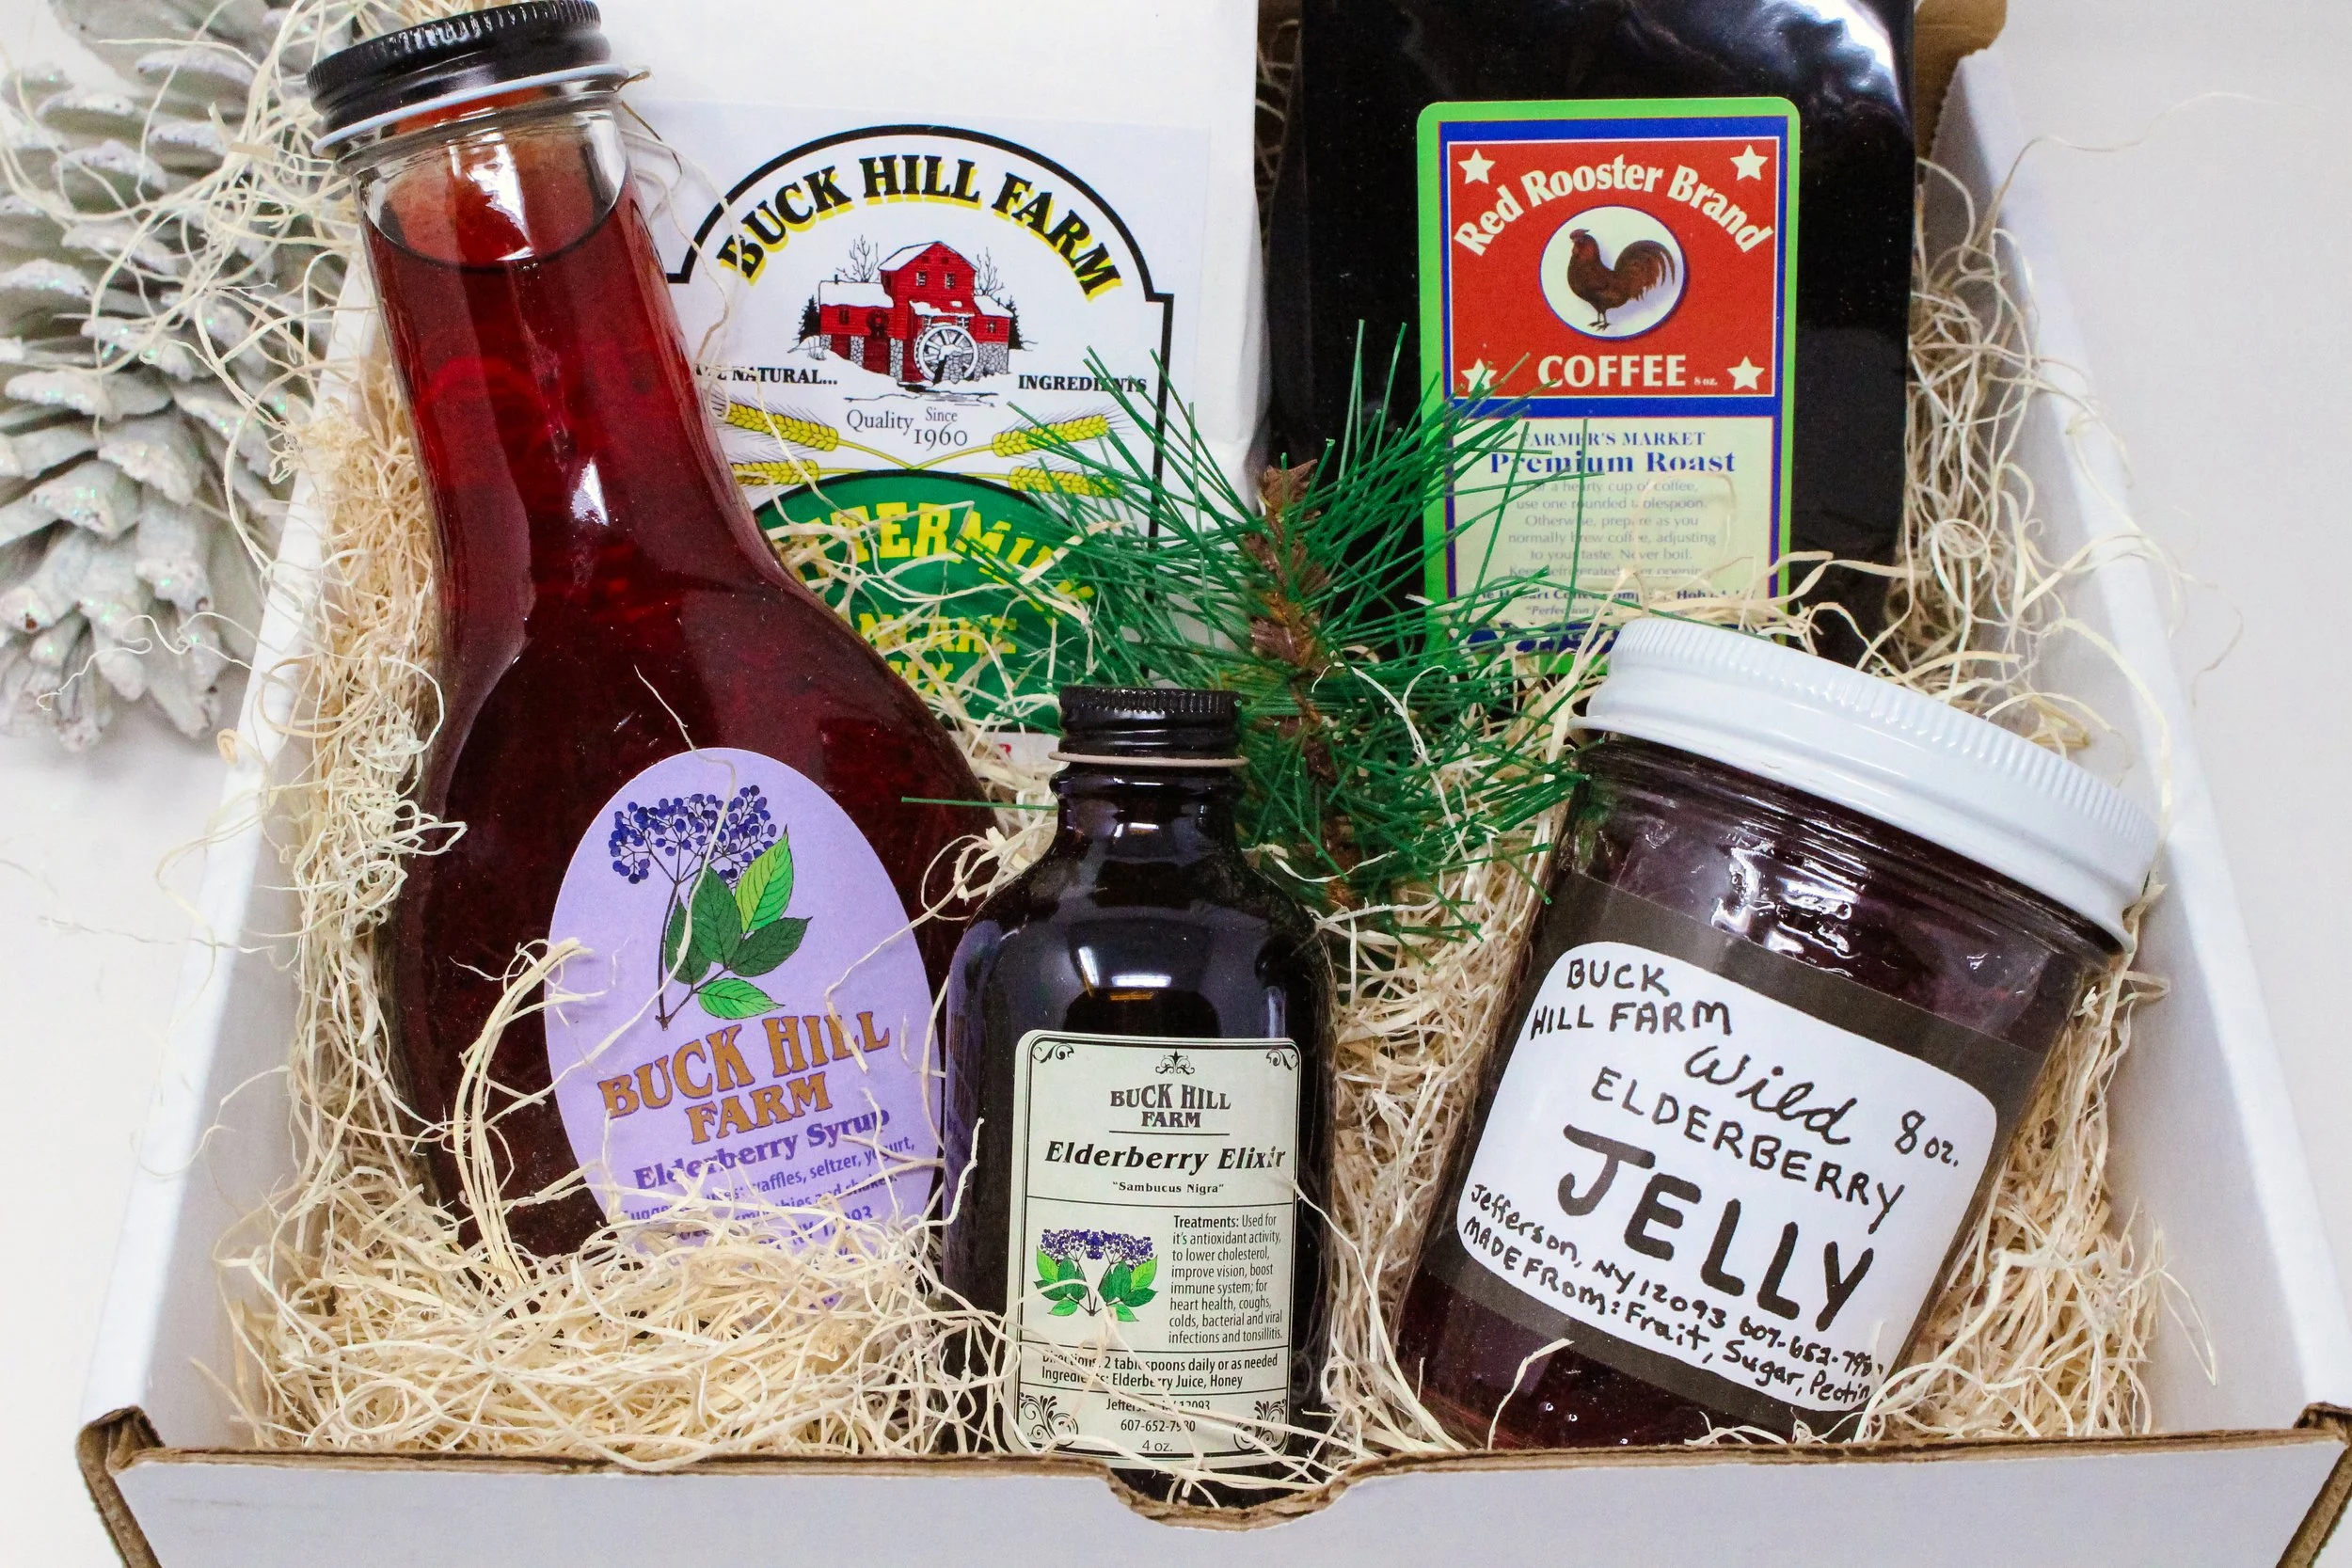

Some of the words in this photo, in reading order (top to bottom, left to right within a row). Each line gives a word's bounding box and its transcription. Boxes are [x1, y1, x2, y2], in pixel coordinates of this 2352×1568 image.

[1453, 185, 1525, 257] Red
[1519, 153, 1663, 208] Rooster
[1667, 164, 1775, 254] Brand
[717, 165, 852, 286] BUCK
[859, 154, 983, 209] HILL
[992, 172, 1122, 303] FARM
[1537, 354, 1687, 388] COFFEE
[846, 409, 914, 436] Quality
[925, 405, 959, 423] Since
[913, 422, 969, 451] 1960
[1622, 432, 1706, 446] MARKET
[1645, 451, 1736, 473] Roast
[1609, 483, 1631, 495] cup
[1653, 479, 1699, 494] coffee,
[1517, 499, 1538, 510] use
[1542, 499, 1567, 510] one
[1656, 517, 1670, 526] as
[1674, 517, 1699, 530] you
[1508, 531, 1567, 546] normally
[1656, 531, 1717, 546] adjusting
[1531, 549, 1543, 561] to
[1581, 549, 1615, 561] taste.
[1663, 546, 1692, 561] boil.
[1566, 958, 1671, 997] BUCK
[1530, 1004, 1595, 1041] HILL
[1609, 999, 1733, 1037] FARM
[596, 1024, 756, 1120] BUCK
[762, 1010, 891, 1079] HILL
[1110, 1083, 1173, 1109] BUCK
[1181, 1085, 1232, 1111] HILL
[1684, 1045, 1858, 1146] Wild
[686, 1071, 833, 1145] FARM
[1141, 1111, 1201, 1129] FARM
[1893, 1109, 1926, 1155] 8
[1924, 1136, 1961, 1168] oz.
[1044, 1141, 1210, 1176] Elderberry
[1217, 1146, 1286, 1170] Elixir
[1591, 1065, 1906, 1235] ELDERBERRY
[809, 1154, 863, 1177] seltzer,
[1112, 1181, 1182, 1194] "Sambucus
[1186, 1182, 1225, 1196] Nigra"
[1173, 1214, 1239, 1228] Treatments:
[1242, 1213, 1263, 1227] Used
[1265, 1212, 1278, 1227] for
[1557, 1123, 1875, 1333] JELLY
[1172, 1231, 1187, 1245] it's
[1190, 1230, 1247, 1245] antioxidant
[1248, 1229, 1281, 1245] activity,
[1172, 1249, 1184, 1261] to
[1185, 1247, 1216, 1261] lower
[1217, 1245, 1270, 1261] cholesterol,
[1471, 1183, 1582, 1269] Jefferson,
[1592, 1259, 1636, 1295] NY
[1638, 1279, 1727, 1329] 12093
[1171, 1264, 1215, 1281] improve
[1216, 1264, 1248, 1279] vision,
[1249, 1262, 1274, 1276] boost
[1170, 1281, 1216, 1294] immune
[1217, 1281, 1254, 1297] system;
[1255, 1278, 1268, 1292] for
[1169, 1297, 1199, 1311] heart
[1201, 1296, 1236, 1312] health,
[1239, 1294, 1272, 1312] coughs,
[1463, 1216, 1522, 1271] MADE
[1625, 1301, 1714, 1364] Fruit,
[1722, 1339, 1804, 1397] Sugar,
[1809, 1370, 1871, 1404] Pectin
[1168, 1313, 1200, 1329] colds,
[1202, 1312, 1245, 1327] bacterial
[1247, 1311, 1263, 1325] and
[1264, 1308, 1282, 1323] viral
[1168, 1330, 1220, 1344] infections
[1222, 1329, 1241, 1343] and
[1242, 1327, 1283, 1342] tonsillitis.
[1104, 1355, 1112, 1370] 2
[1187, 1357, 1216, 1374] daily
[1217, 1360, 1230, 1370] or
[1231, 1359, 1243, 1370] as
[1244, 1353, 1279, 1370] needed
[1175, 1374, 1207, 1388] Juice,
[1210, 1373, 1244, 1389] Honey
[1141, 1439, 1151, 1451] 4
[1154, 1441, 1173, 1452] oz.
